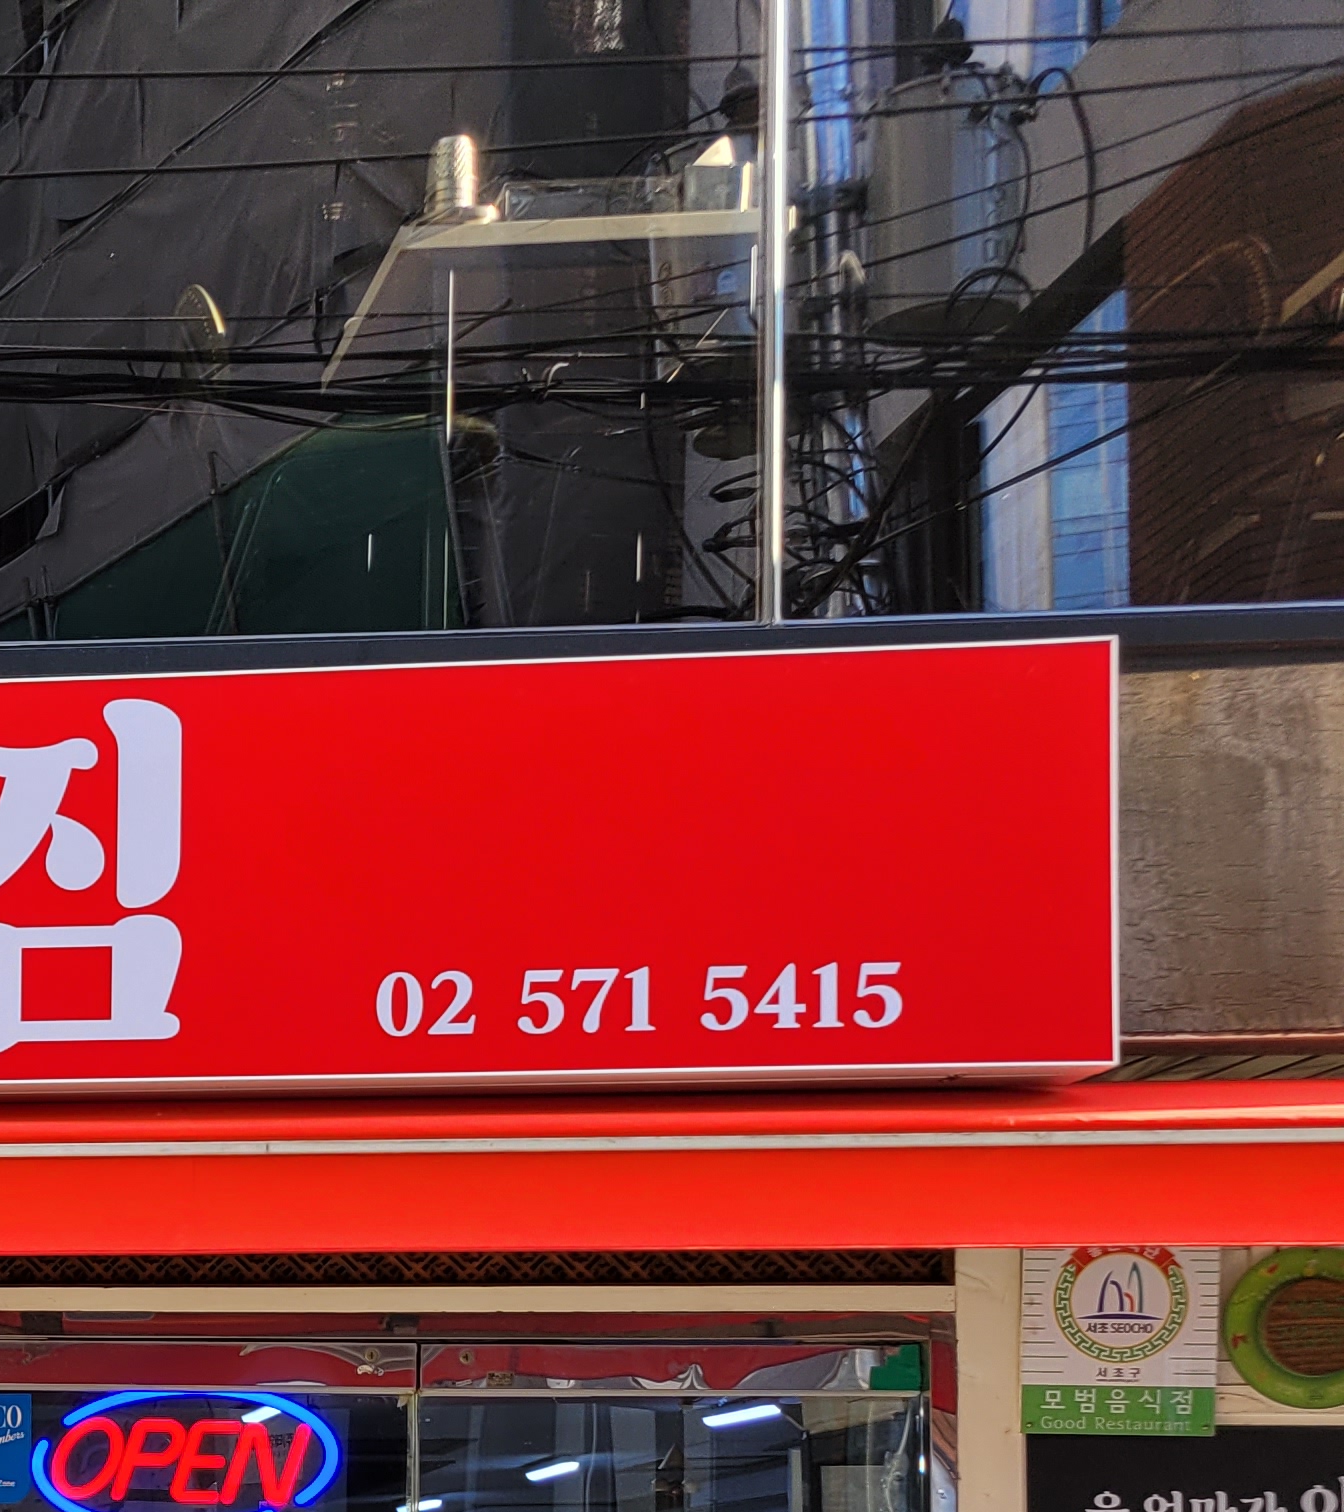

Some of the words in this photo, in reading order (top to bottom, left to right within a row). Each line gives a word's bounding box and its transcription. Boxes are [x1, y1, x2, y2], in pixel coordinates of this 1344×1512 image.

[375, 970, 477, 1037] 02
[517, 966, 656, 1035] 571
[700, 961, 903, 1031] 5415
[1085, 1322, 1109, 1334] 서초
[1111, 1322, 1153, 1334] SEOCHO
[1040, 1416, 1086, 1430] Good
[1095, 1417, 1191, 1431] Restaurant
[52, 1416, 311, 1507] OPEN
